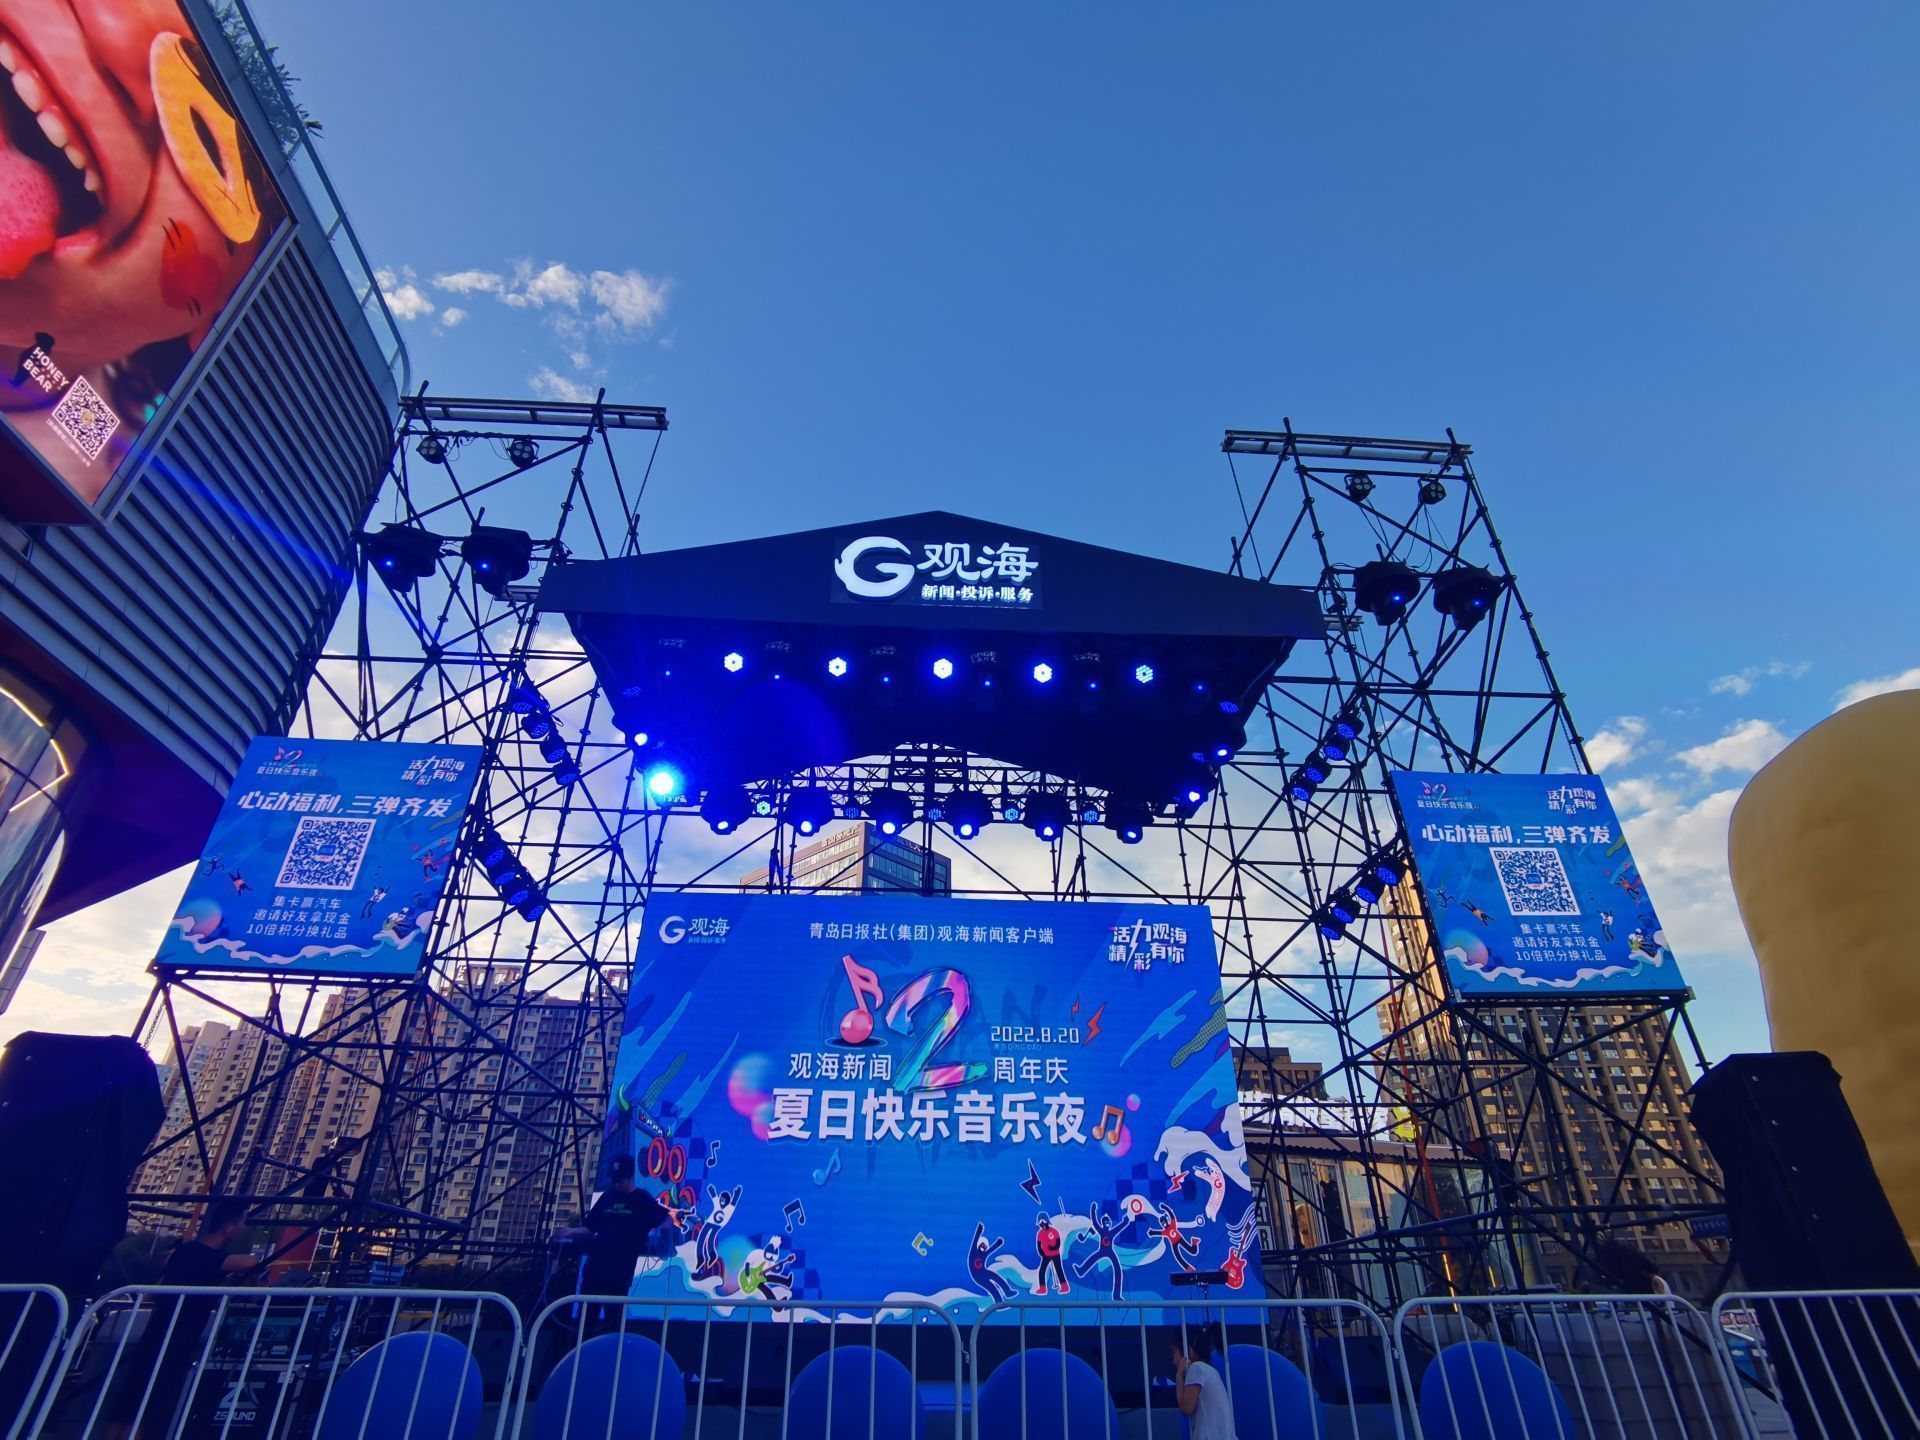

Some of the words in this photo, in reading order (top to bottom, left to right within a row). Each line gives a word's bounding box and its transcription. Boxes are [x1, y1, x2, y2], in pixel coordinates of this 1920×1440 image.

[23, 359, 53, 392] BEAR
[33, 347, 69, 388] HONEY
[917, 541, 1039, 583] 观海
[254, 909, 352, 924] 邀请好友拿现金
[688, 917, 730, 936] 观海
[246, 923, 348, 938] 10倍积分换礼品
[809, 922, 1054, 945] 青岛日报社(集团)观海新闻客户端
[1112, 919, 1187, 947] 活力观海
[1513, 936, 1599, 948] 邀请好友拿现金
[1516, 950, 1607, 961] 10倍积分换礼品
[991, 1025, 1080, 1044] 2022.8.20
[788, 1052, 892, 1081] 观海新闻
[993, 1056, 1069, 1085] 周年庆
[767, 1087, 1088, 1145] 夏日快乐音乐夜
